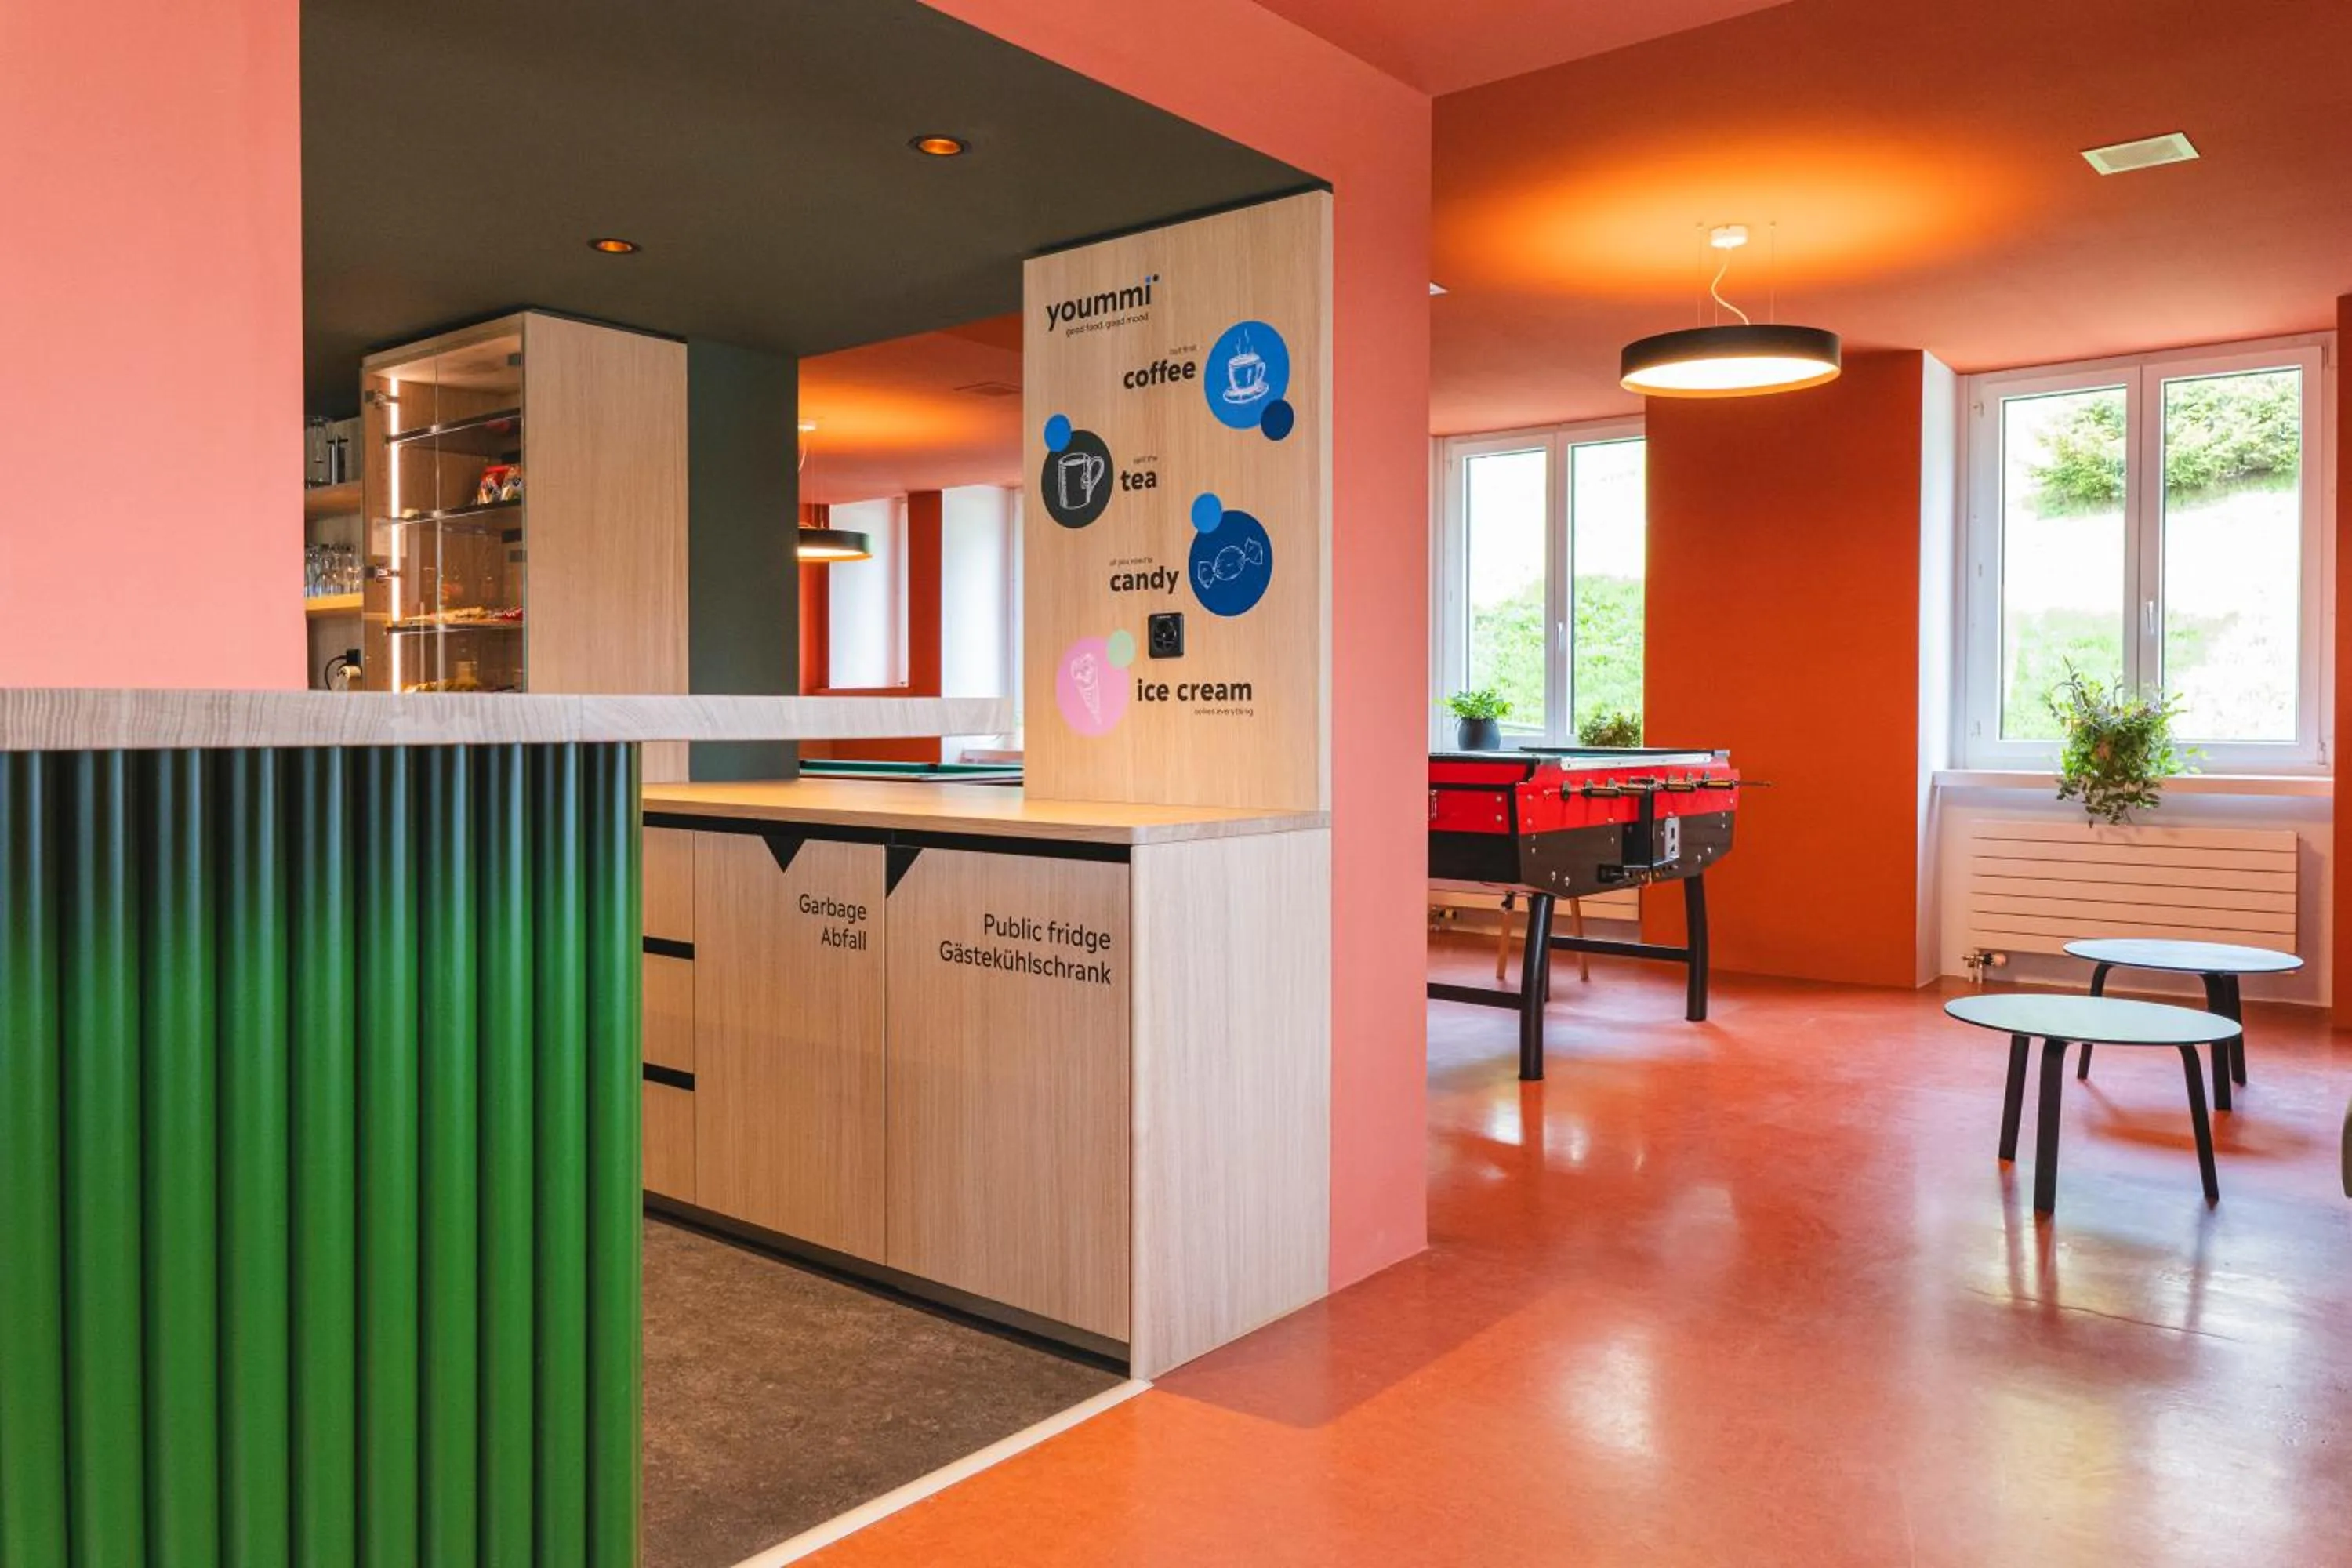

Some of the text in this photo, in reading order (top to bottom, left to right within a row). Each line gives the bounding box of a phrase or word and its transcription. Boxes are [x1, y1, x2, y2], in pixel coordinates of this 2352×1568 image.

[1123, 359, 1196, 390] coffee
[1120, 470, 1157, 491] tea
[1109, 565, 1180, 594] candy
[1137, 678, 1253, 702] ice cream
[799, 893, 867, 924] Garbage
[821, 927, 867, 951] Abfall
[984, 913, 1111, 953] Public fridge
[940, 940, 1112, 985] Gästekühlschrank
